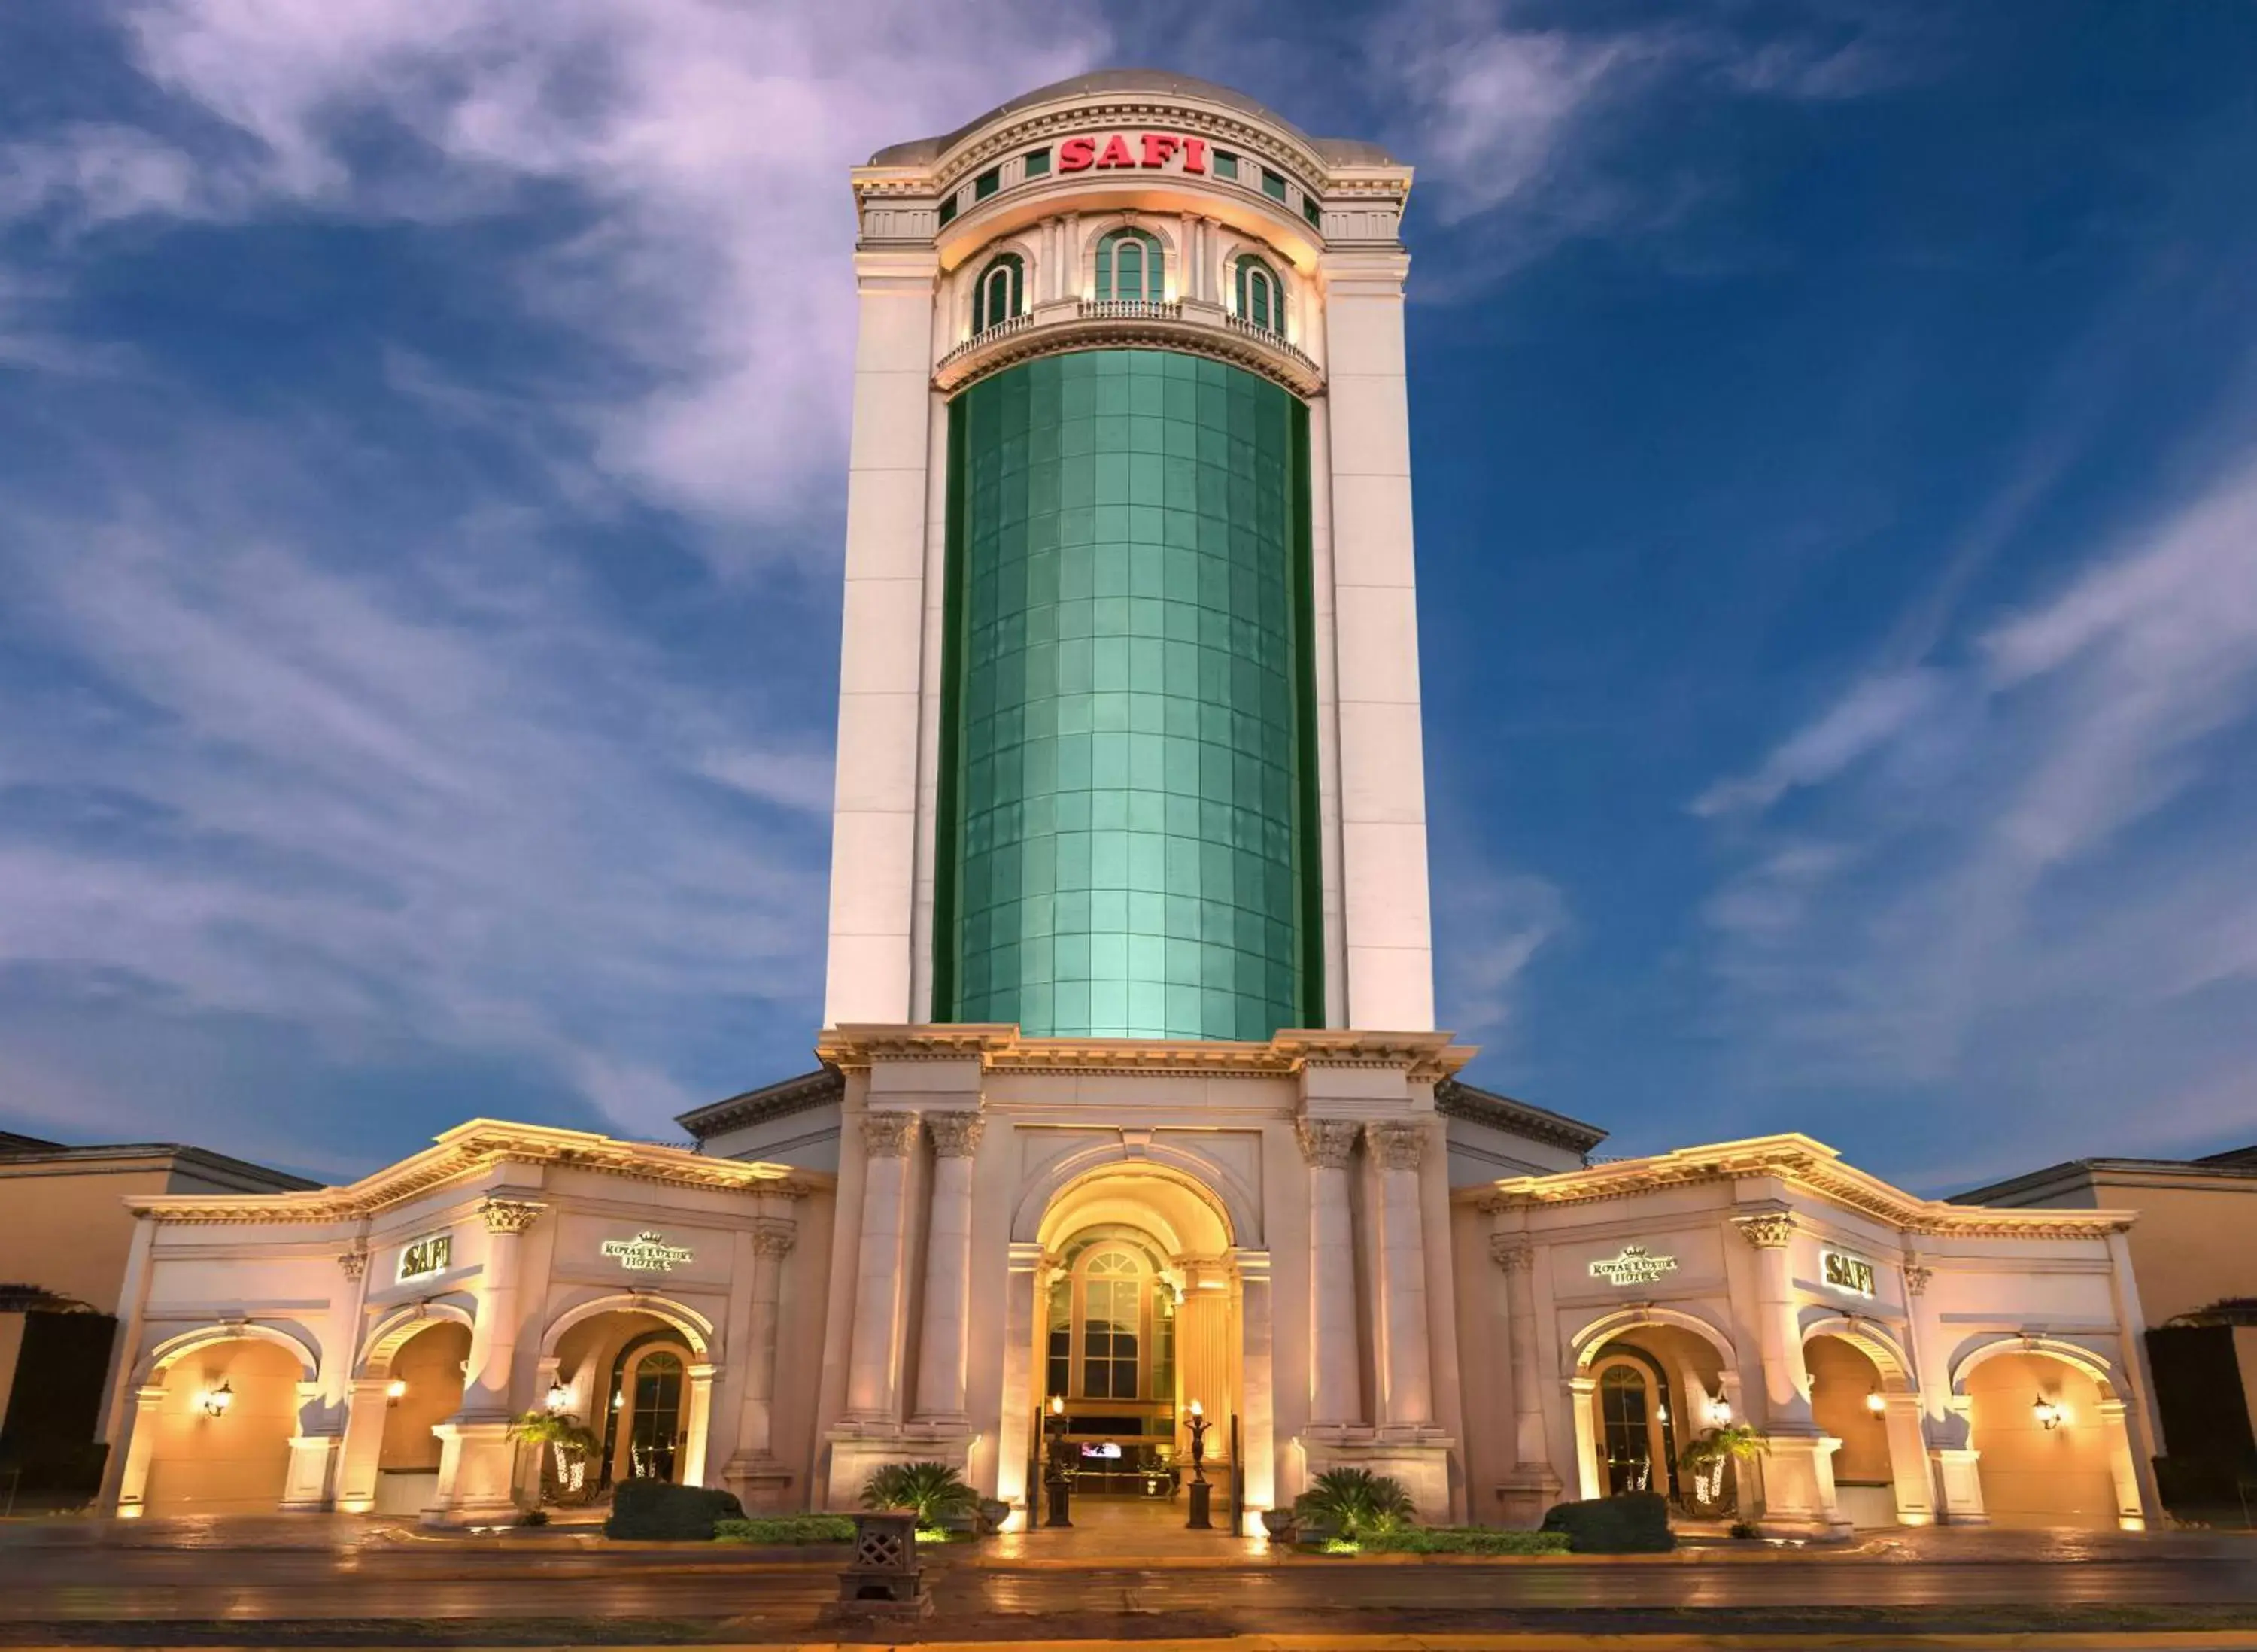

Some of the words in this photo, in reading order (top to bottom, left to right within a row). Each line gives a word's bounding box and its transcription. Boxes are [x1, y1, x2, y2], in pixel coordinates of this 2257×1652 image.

[1059, 133, 1205, 174] SAFI
[400, 1236, 452, 1279] SAFI
[605, 1244, 642, 1256] ROYAL
[1825, 1253, 1876, 1296] SAFI
